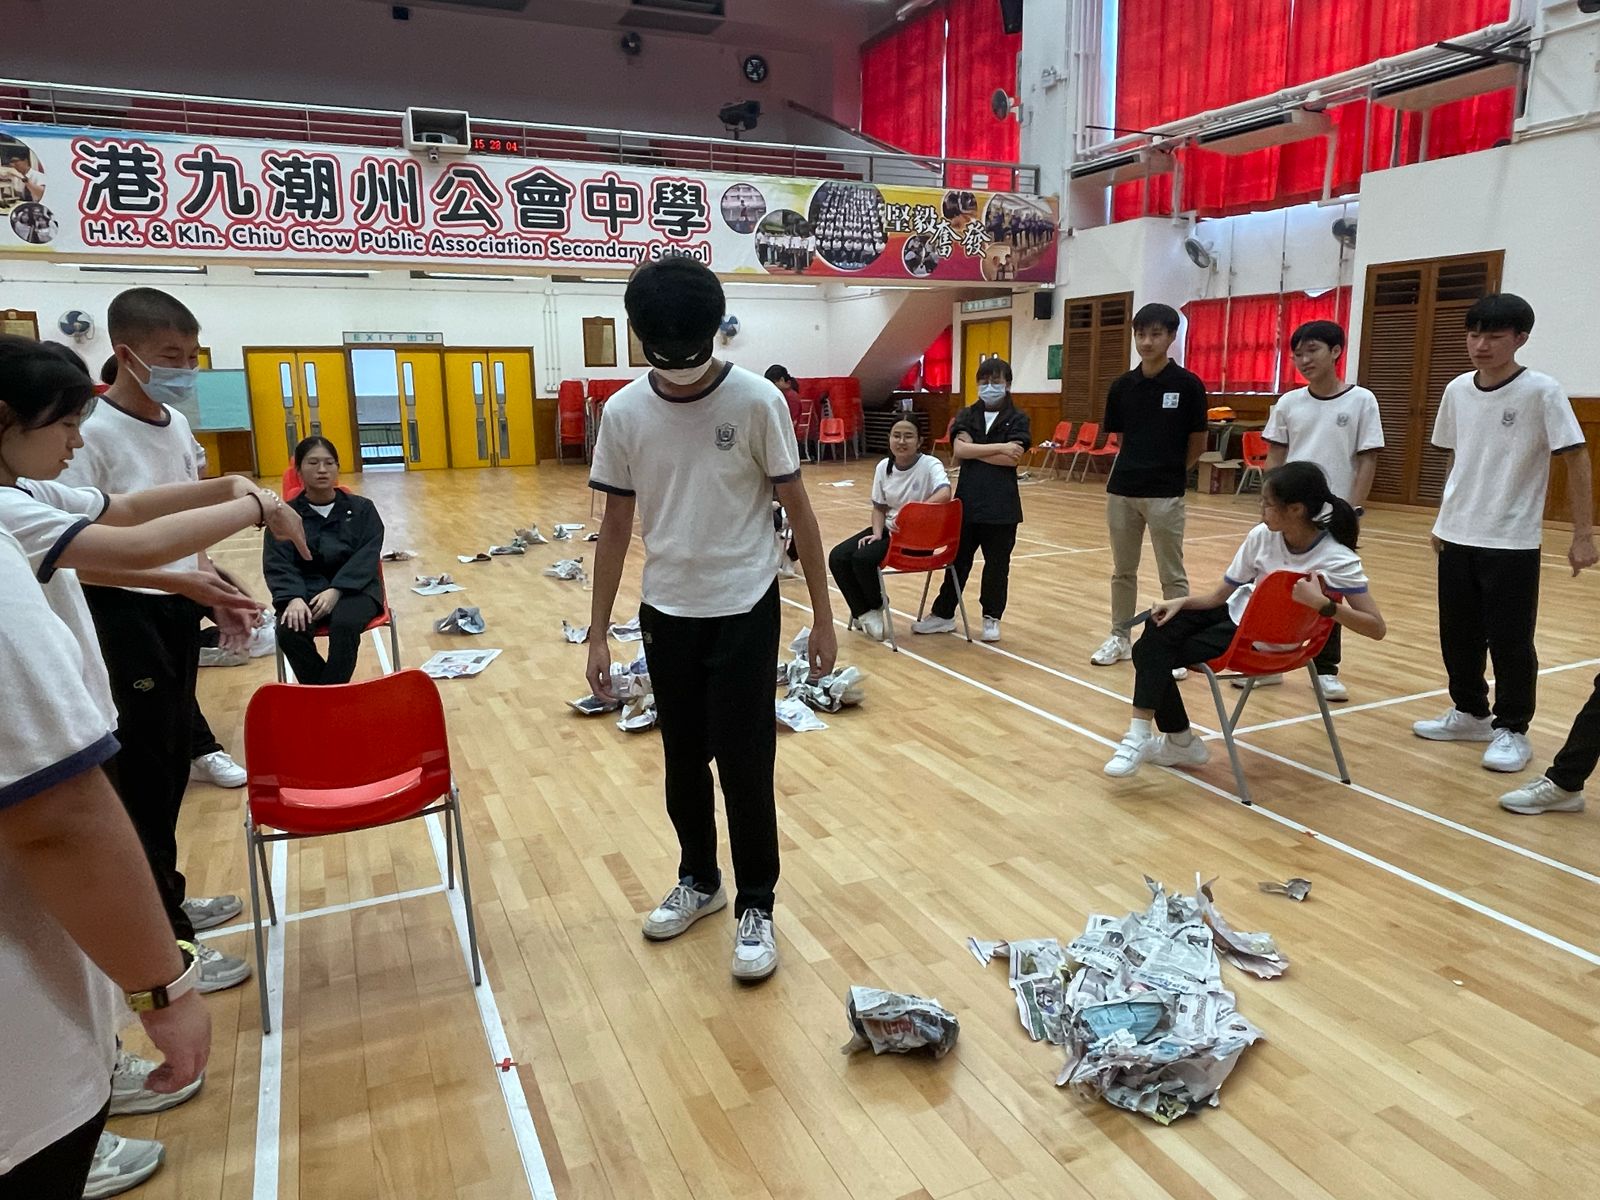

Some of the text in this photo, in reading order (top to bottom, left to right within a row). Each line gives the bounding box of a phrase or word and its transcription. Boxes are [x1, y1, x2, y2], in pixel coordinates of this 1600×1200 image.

[474, 139, 485, 149] 15
[506, 141, 518, 151] 04
[78, 143, 707, 237] 港九潮州公會中學
[87, 222, 141, 242] H.K.
[151, 224, 169, 242] &
[232, 226, 282, 245] Chiu
[291, 228, 352, 247] Chow
[361, 231, 425, 250] Public
[431, 234, 543, 255] Association
[549, 238, 646, 262] Secondary
[353, 333, 394, 342] EXIT
